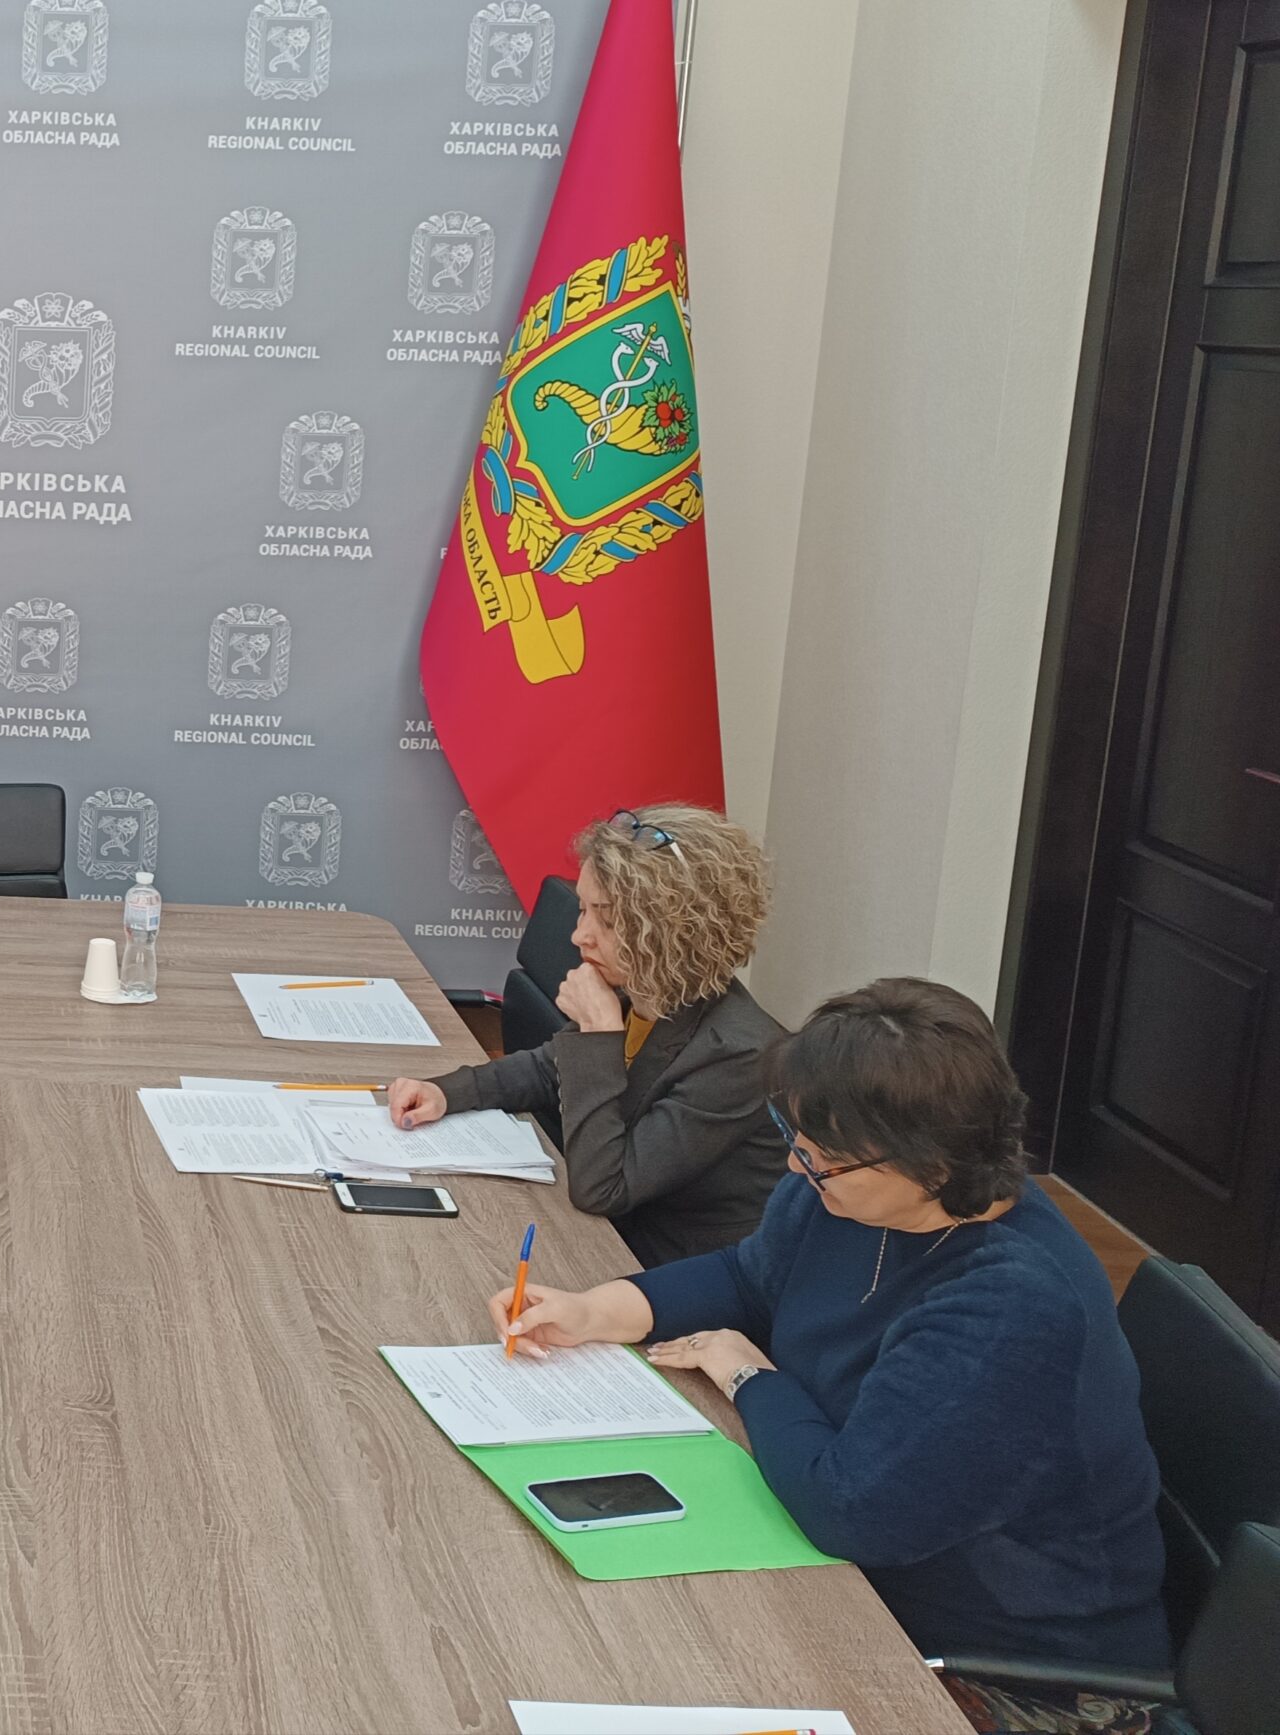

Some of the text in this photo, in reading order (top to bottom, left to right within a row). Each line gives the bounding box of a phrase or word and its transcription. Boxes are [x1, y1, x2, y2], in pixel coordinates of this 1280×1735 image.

[7, 109, 117, 127] ХАРКІВСЬКА
[245, 116, 322, 132] KHARKIV
[449, 121, 559, 137] ХАРКІВСЬКА
[2, 129, 121, 149] ОБЛАСНА РАДА
[207, 134, 356, 152] REGIONAL COUNCIL
[443, 140, 562, 160] ОБЛАСНА РАДА
[211, 325, 287, 340] KHARKIV
[392, 329, 499, 344] ХАРКІВСЬКА
[174, 343, 321, 359] REGIONAL COUNCIL
[386, 348, 502, 366] ОБЛАСНА РАДА
[72, 502, 132, 525] РАДА
[264, 525, 370, 540] ХАРКІВСЬКА
[258, 543, 373, 561] ОБЛАСНА РАДА
[465, 528, 501, 620] ОБЛАСТЬ
[209, 713, 283, 728] KHARKIV
[52, 726, 91, 742] РАДА
[173, 729, 316, 747] REGIONAL COUNCIL
[399, 737, 440, 751] ОБЛА
[80, 893, 123, 902] KHAR
[450, 907, 524, 922] KHARKIV
[414, 923, 488, 938] REGIONAL
